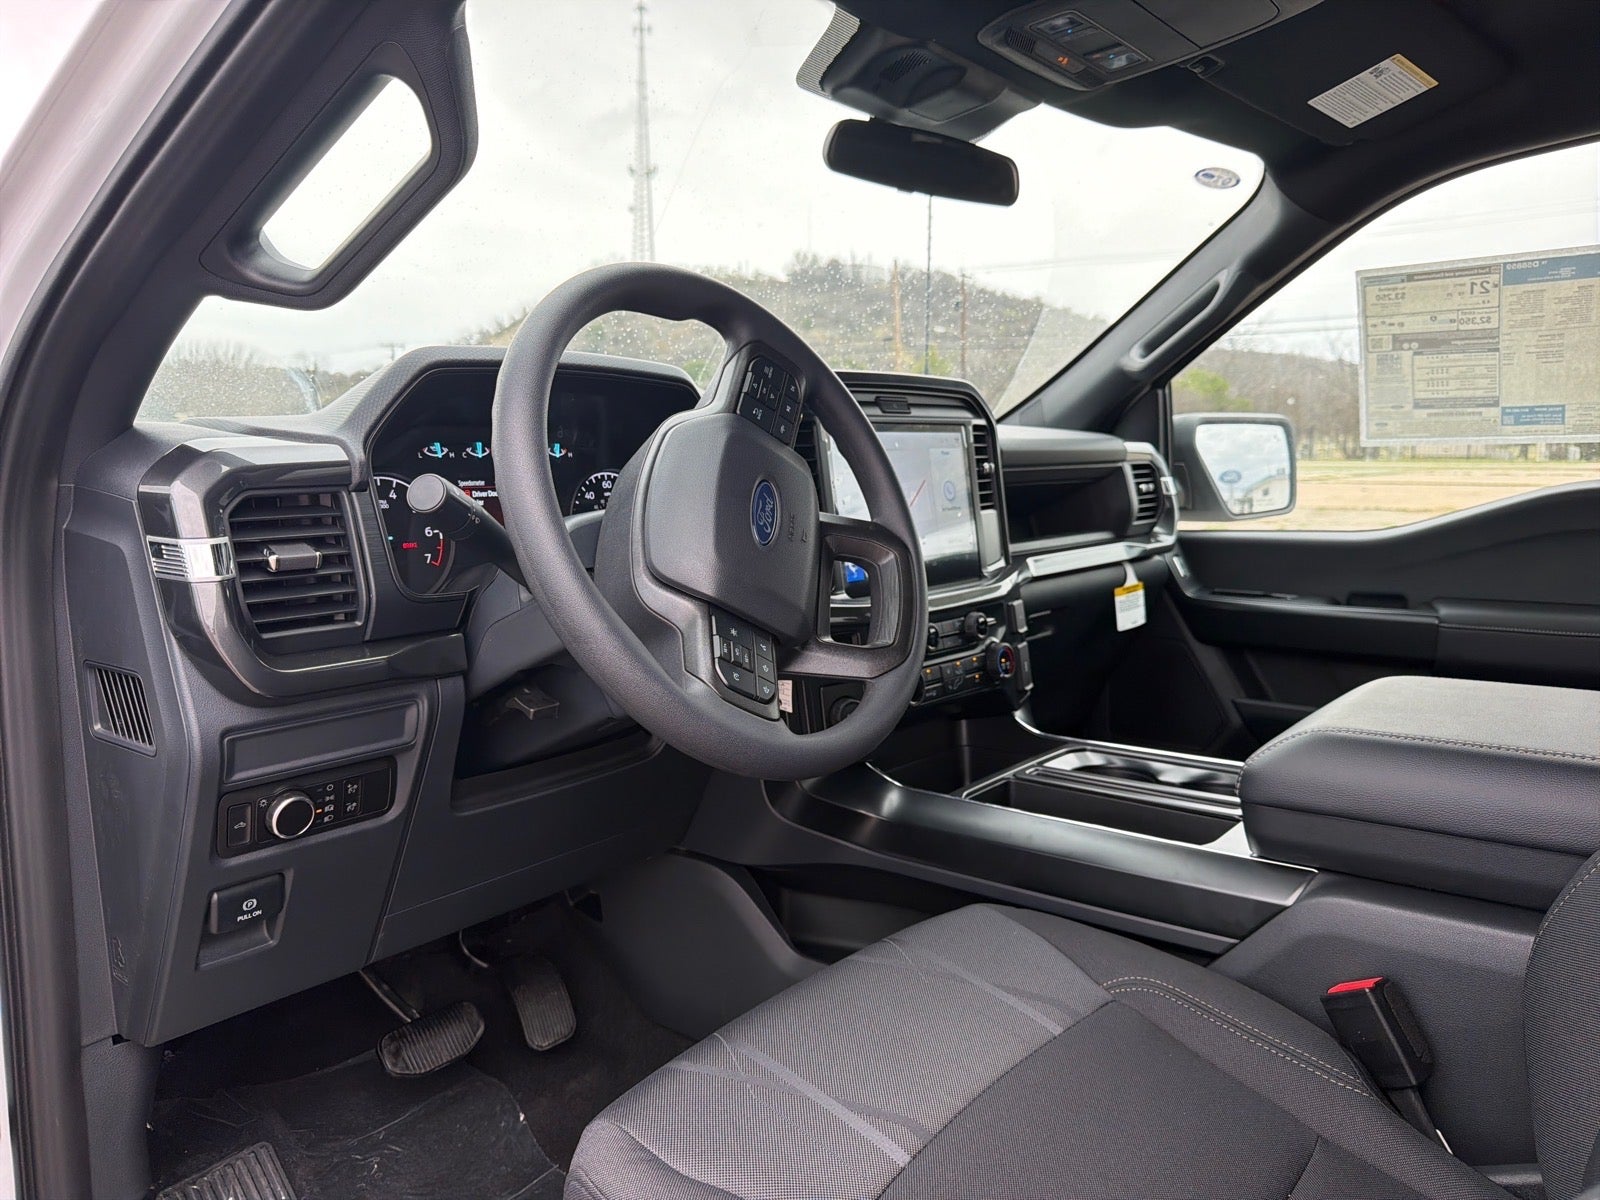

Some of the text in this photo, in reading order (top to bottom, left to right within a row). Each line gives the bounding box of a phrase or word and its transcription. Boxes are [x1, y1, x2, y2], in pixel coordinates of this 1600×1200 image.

[602, 480, 612, 489] 60
[388, 490, 397, 500] 4
[584, 492, 595, 500] 40
[756, 492, 774, 533] Ford
[424, 526, 433, 537] 6
[424, 554, 432, 564] 7
[236, 913, 252, 922] PULL
